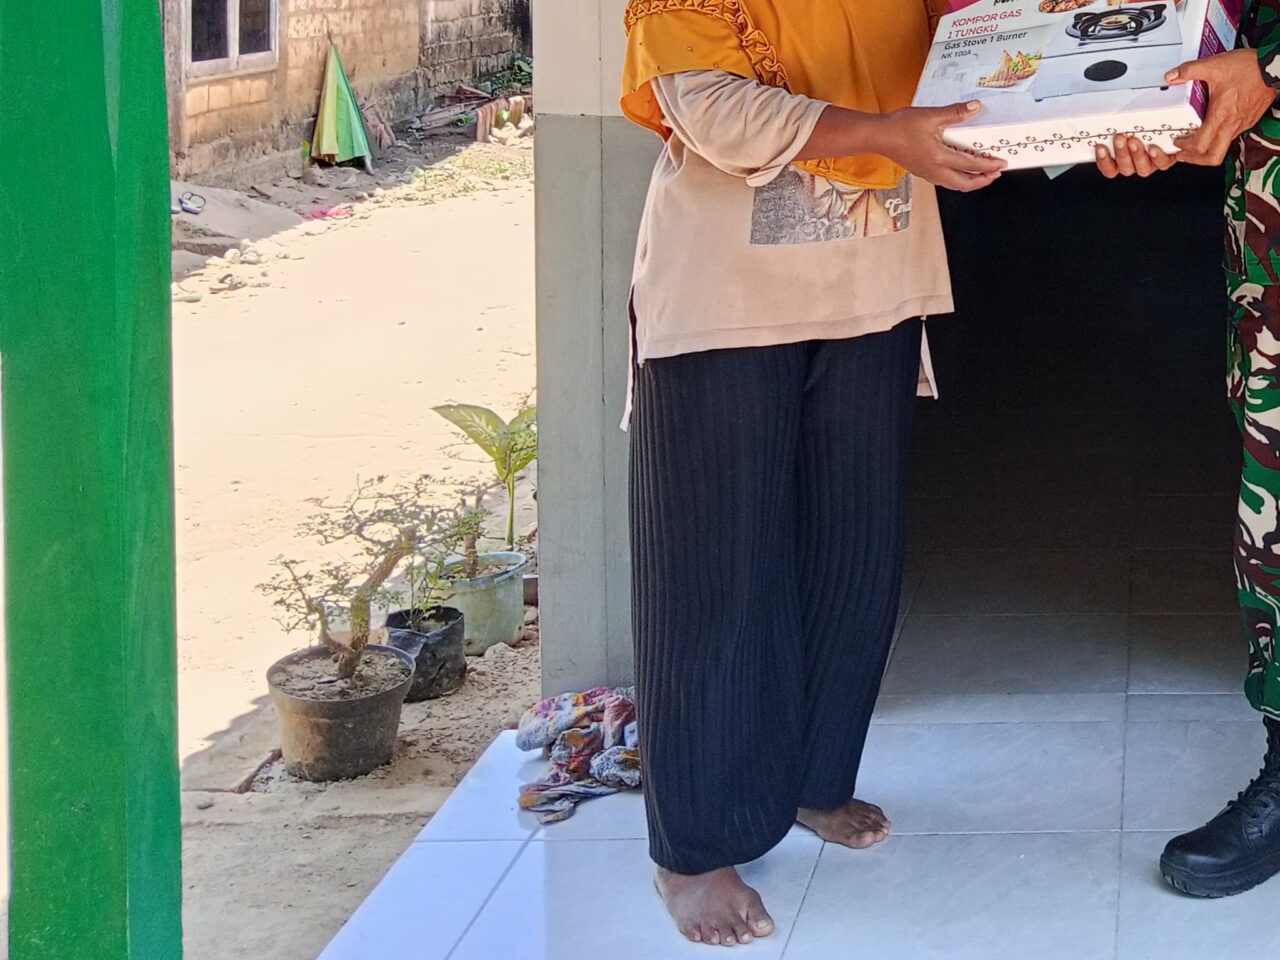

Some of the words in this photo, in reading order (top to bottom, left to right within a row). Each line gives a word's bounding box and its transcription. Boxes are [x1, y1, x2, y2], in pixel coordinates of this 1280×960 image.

[952, 13, 998, 28] KOMPOR
[1000, 8, 1023, 20] GAS
[944, 41, 961, 51] Gas
[962, 37, 987, 48] Stove
[990, 35, 994, 43] 1
[996, 31, 1028, 43] Burner
[955, 24, 998, 38] TUNGKU
